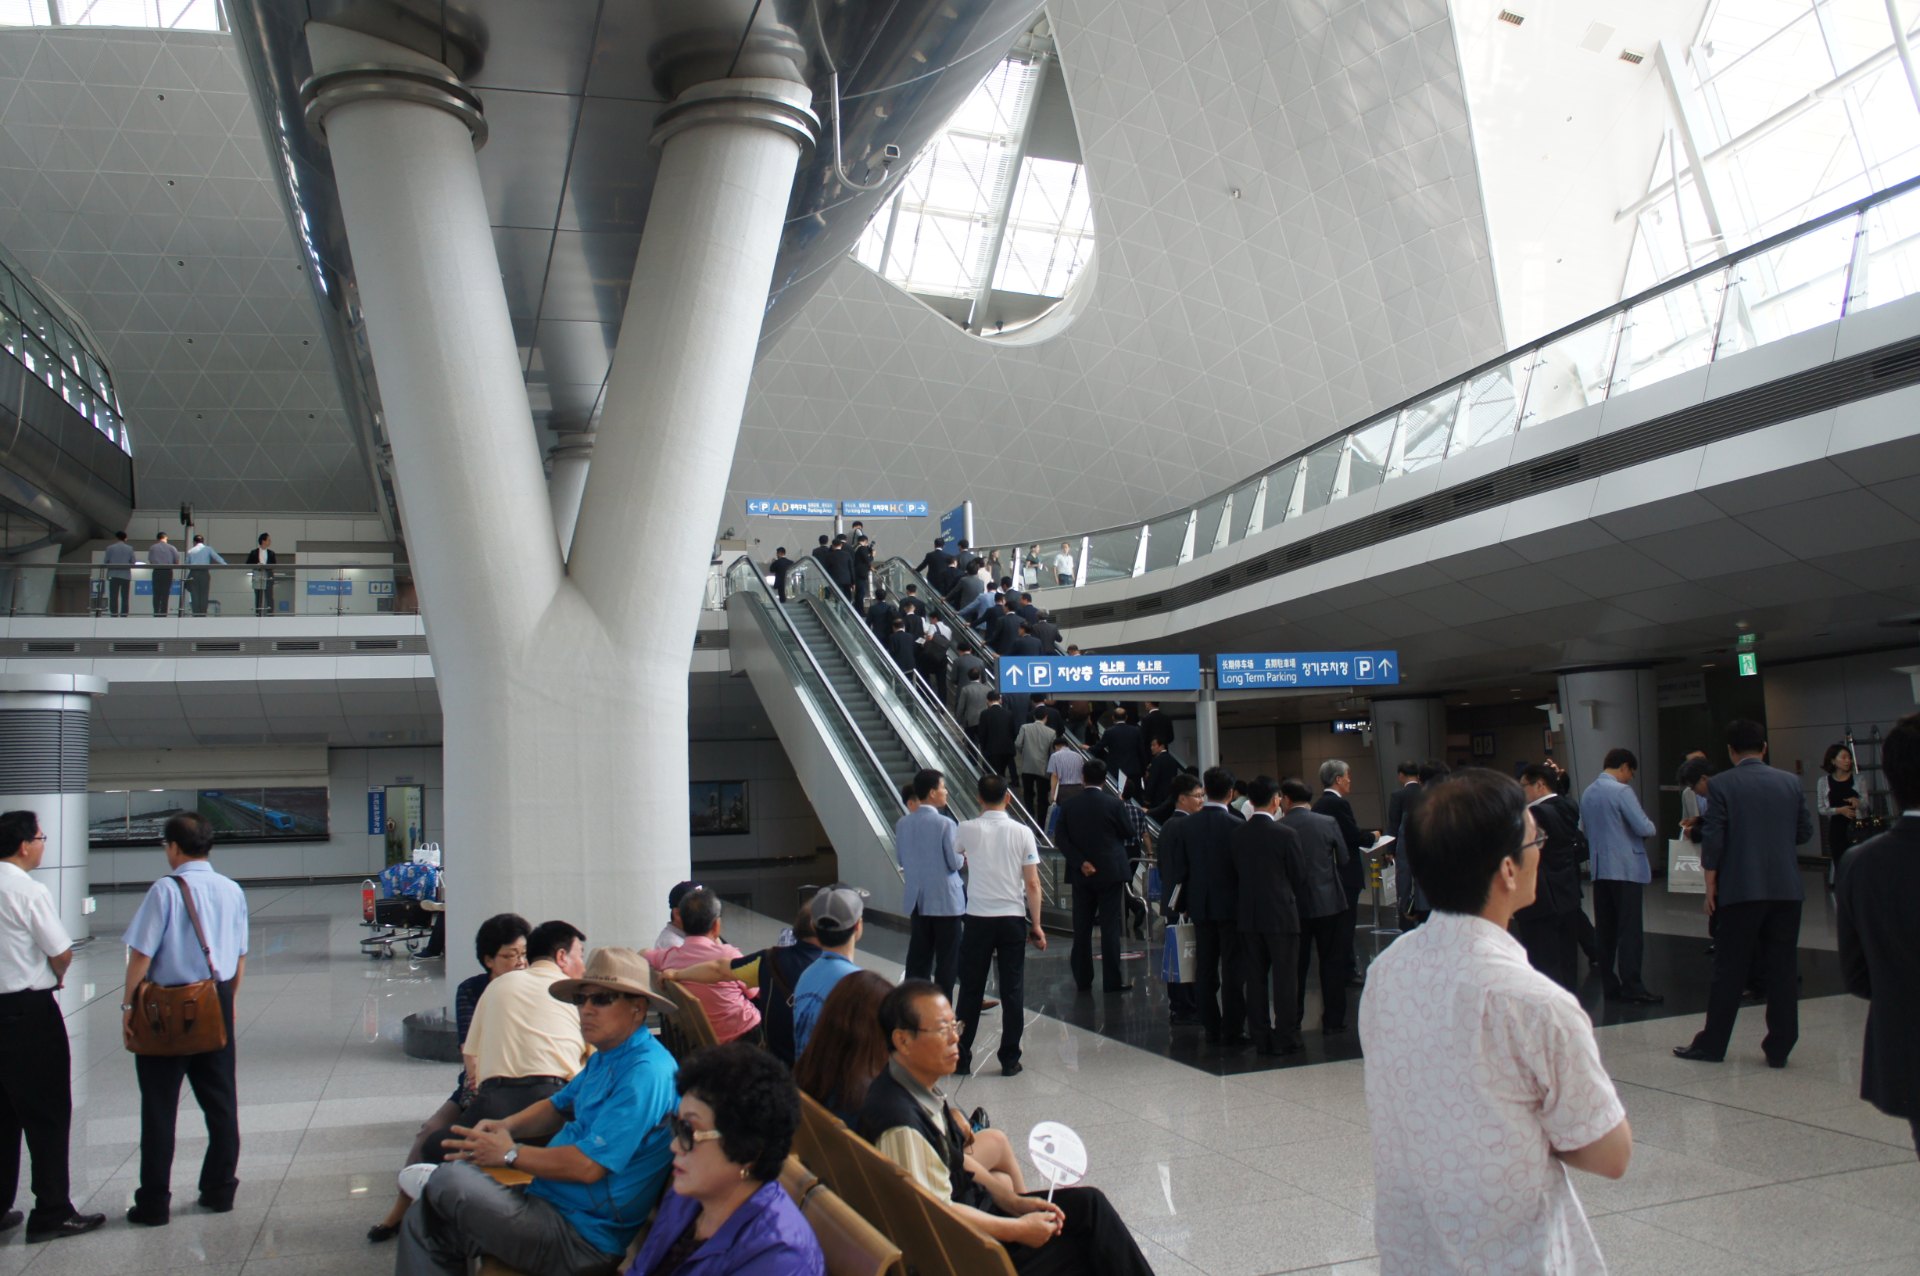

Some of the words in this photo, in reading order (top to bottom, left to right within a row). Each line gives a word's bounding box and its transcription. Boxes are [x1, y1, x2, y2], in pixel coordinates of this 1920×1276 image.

[761, 503, 768, 511] P
[1033, 666, 1047, 684] P
[1057, 666, 1093, 682] 지상층
[1302, 661, 1348, 677] 장기주차장
[1359, 660, 1371, 677] P
[1099, 674, 1140, 686] Ground
[1143, 674, 1170, 685] Floor
[1222, 673, 1243, 686] Long
[1244, 672, 1265, 683] Term
[1266, 671, 1297, 684] Parking
